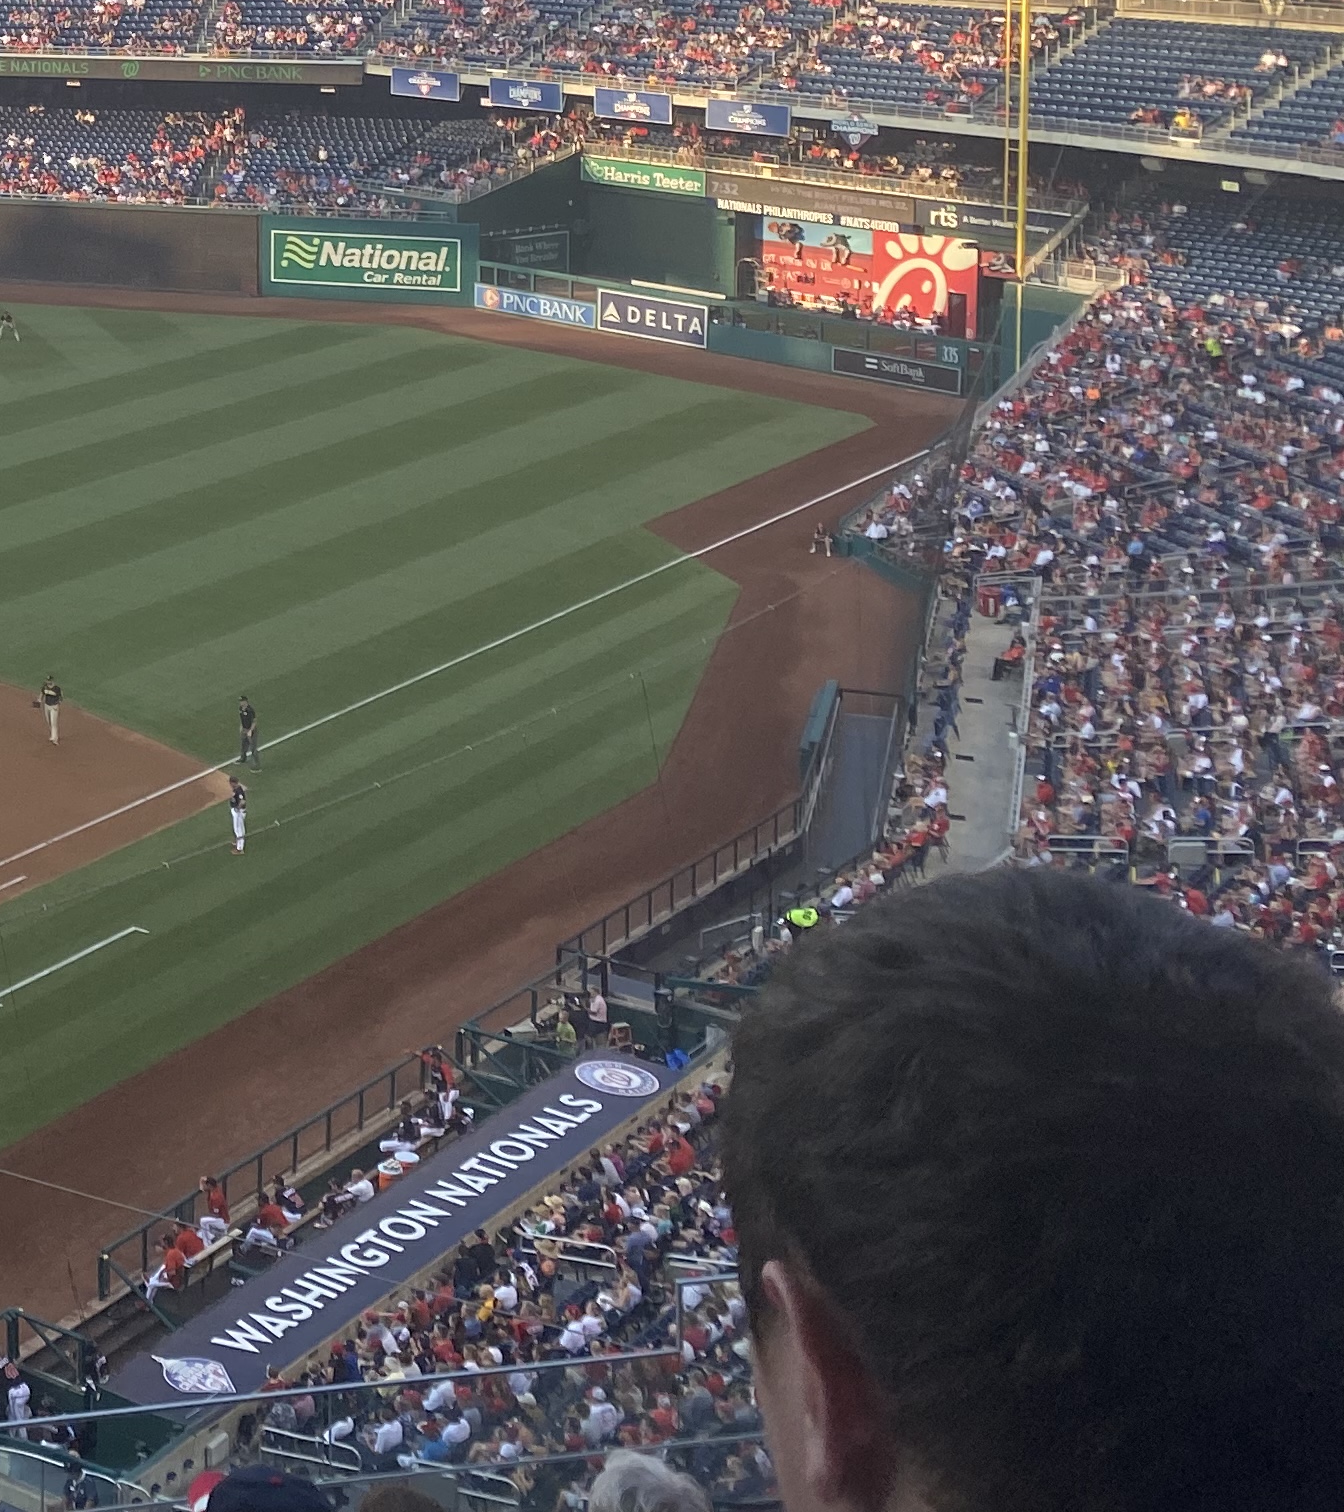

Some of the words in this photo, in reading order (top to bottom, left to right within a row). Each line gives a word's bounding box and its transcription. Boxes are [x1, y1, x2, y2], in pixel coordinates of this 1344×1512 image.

[11, 60, 89, 74] NATIONALS
[604, 165, 650, 186] Harris
[653, 171, 702, 193] Teeter
[717, 198, 762, 216] NATIONALS
[764, 204, 834, 226] PHILANTHROPIES
[840, 215, 900, 234] #NATS4GOOD
[363, 271, 389, 284] Car
[393, 272, 442, 287] Rental
[627, 305, 703, 336] DELTA
[881, 359, 925, 378] SoftBank
[211, 1199, 451, 1354] WASHINGTON
[425, 1094, 603, 1207] NATIONALS
